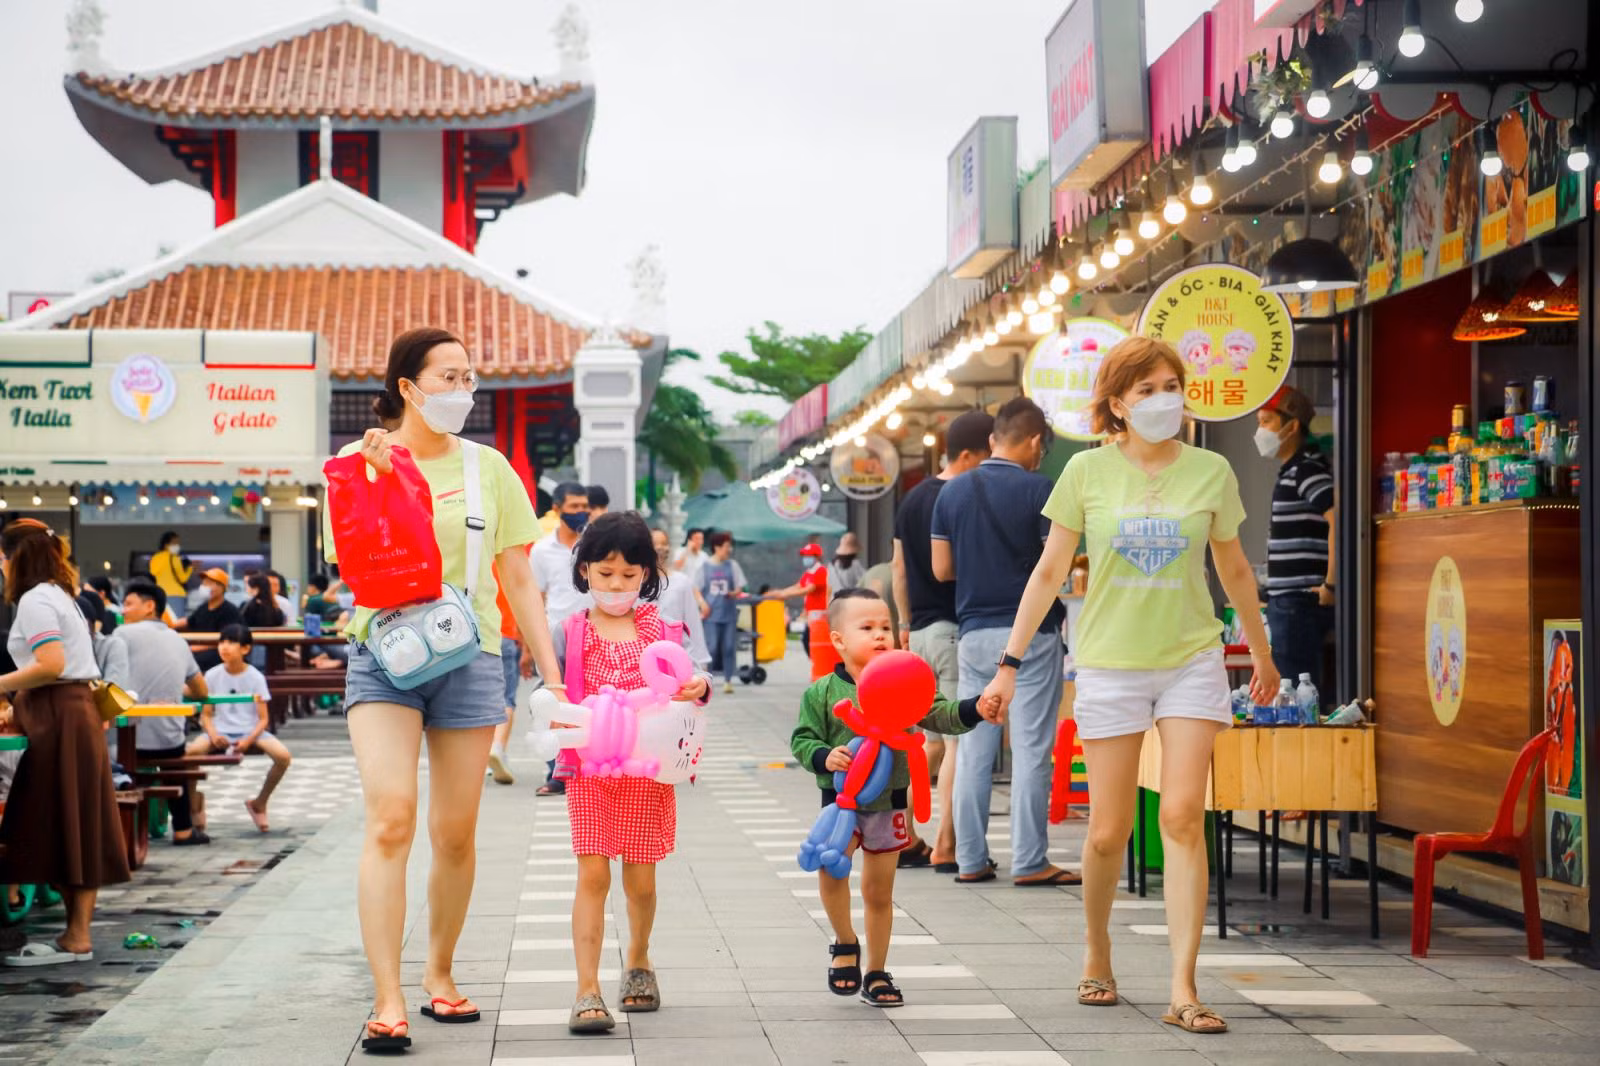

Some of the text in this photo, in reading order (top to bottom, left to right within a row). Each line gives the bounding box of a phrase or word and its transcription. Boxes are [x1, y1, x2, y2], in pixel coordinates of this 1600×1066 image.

[1219, 276, 1243, 292] BIA
[1167, 296, 1179, 308] &
[1255, 295, 1280, 326] GIẢI
[1266, 331, 1283, 374] KHÁT
[206, 382, 277, 401] Italian
[1187, 379, 1248, 406] 해물
[10, 406, 73, 427] Italia
[213, 411, 278, 436] Gelato
[376, 609, 402, 629] RUBYS
